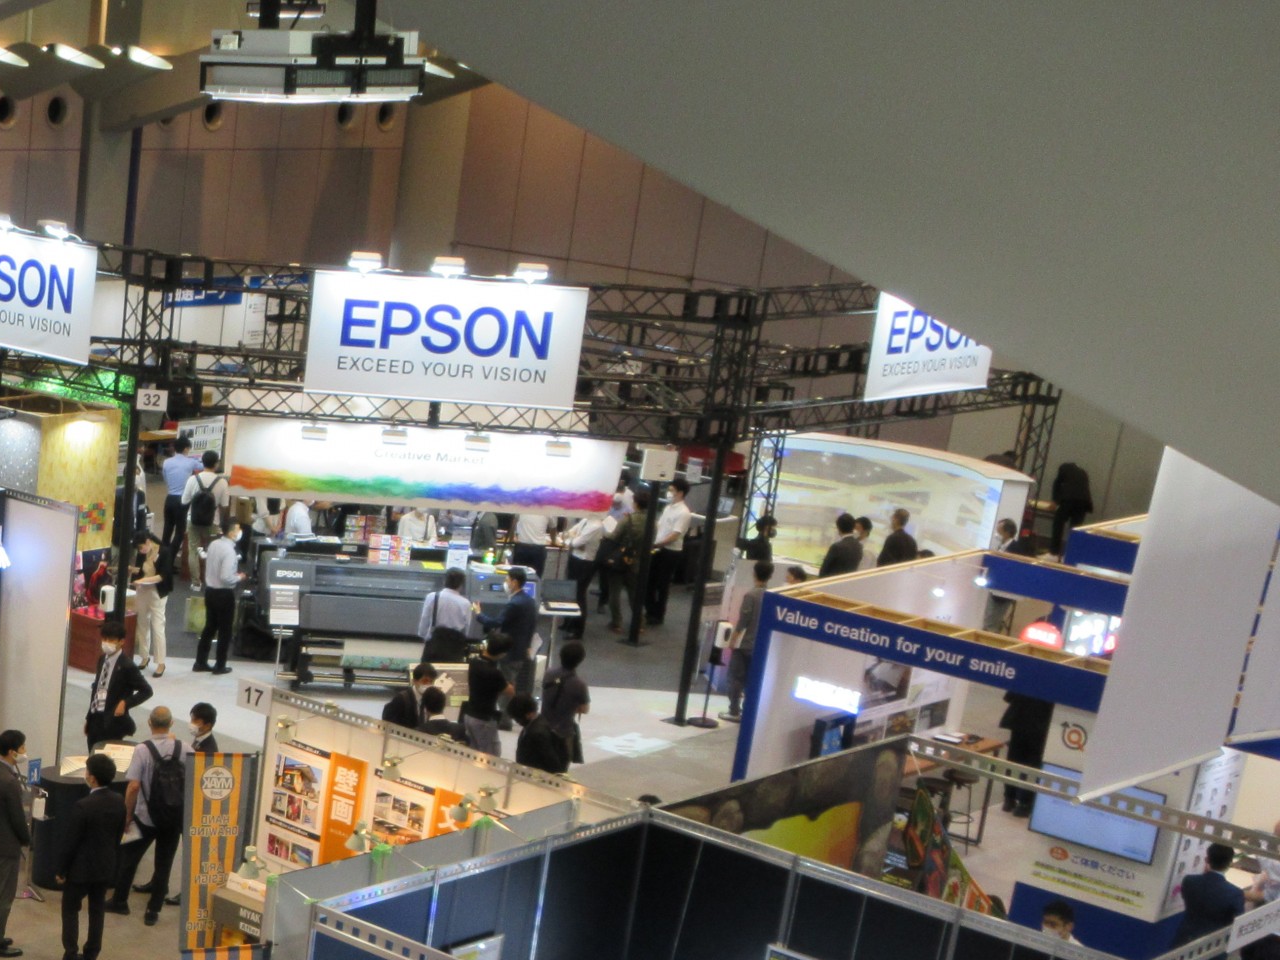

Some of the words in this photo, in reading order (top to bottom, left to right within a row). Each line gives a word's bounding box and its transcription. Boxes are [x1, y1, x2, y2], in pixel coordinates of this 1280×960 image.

[29, 315, 72, 338] VISION
[339, 298, 554, 361] EPSON
[337, 355, 415, 376] EXCEED
[421, 361, 474, 380] YOUR
[483, 365, 548, 385] VISION
[882, 360, 920, 377] EXCEED
[921, 357, 946, 373] YOUR
[949, 355, 980, 370] VISION
[141, 393, 162, 408] 32
[276, 569, 303, 579] EPSON
[776, 605, 819, 630] Value
[824, 619, 890, 648] creation
[896, 635, 919, 656] for
[925, 645, 964, 670] your
[969, 653, 1016, 680] smile
[244, 686, 265, 707] 17
[330, 765, 360, 826] 壁画
